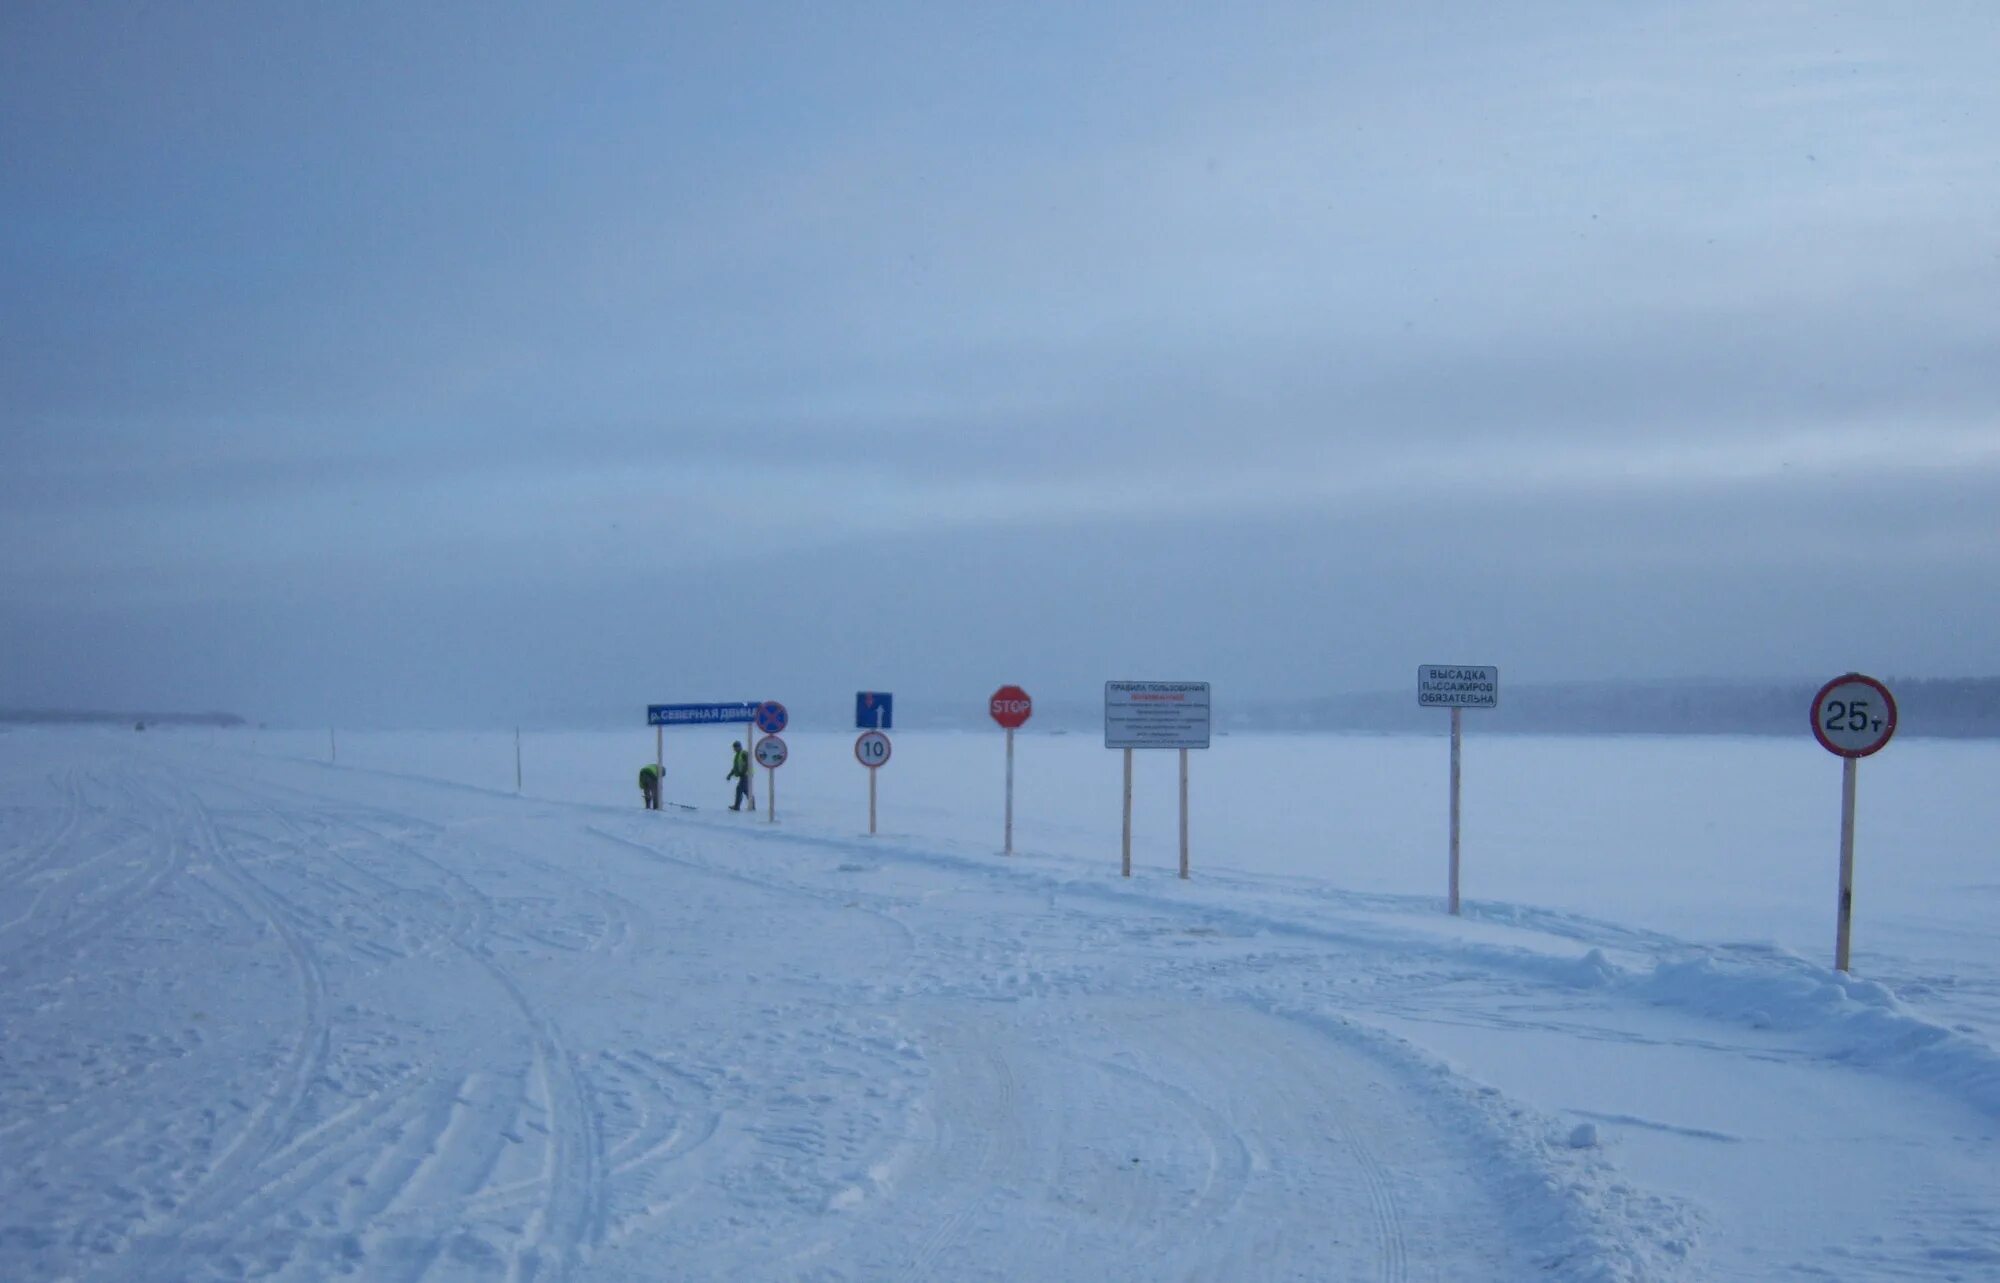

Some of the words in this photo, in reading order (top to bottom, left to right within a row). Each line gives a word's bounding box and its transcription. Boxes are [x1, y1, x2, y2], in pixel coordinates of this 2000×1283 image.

[1429, 669, 1486, 681] ВЫСАДКА
[1421, 693, 1494, 704] ОБЯЗАТЕЛЬНА
[992, 700, 1030, 713] STOP
[660, 709, 719, 720] СЕВЕРНАЯ
[863, 741, 884, 757] 10
